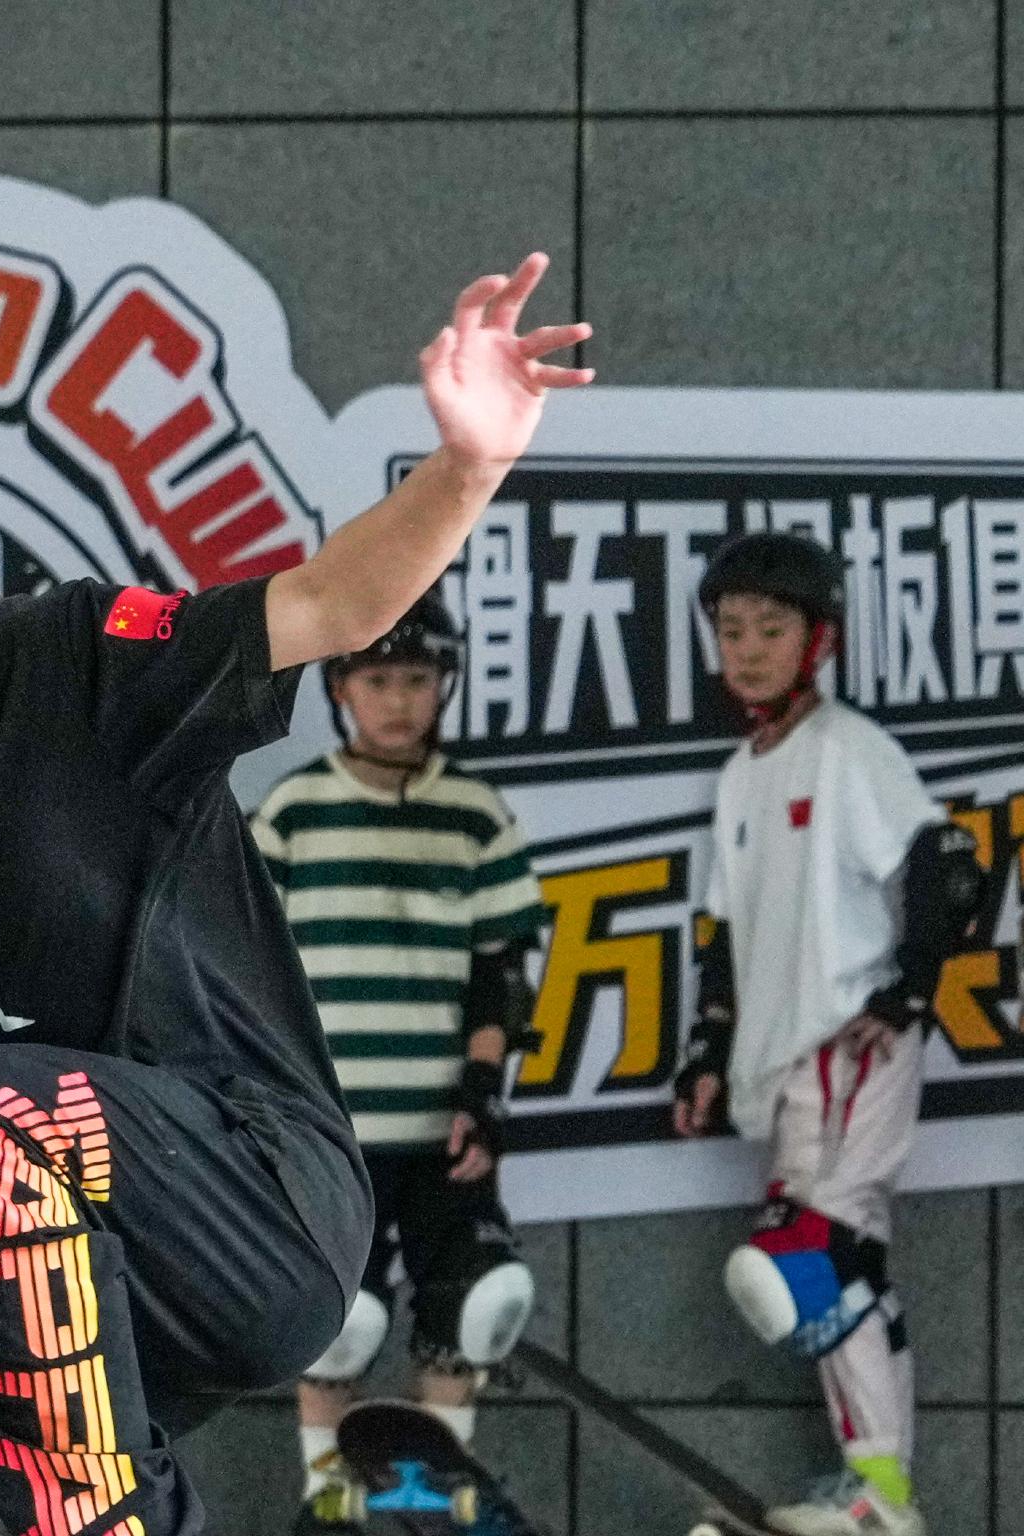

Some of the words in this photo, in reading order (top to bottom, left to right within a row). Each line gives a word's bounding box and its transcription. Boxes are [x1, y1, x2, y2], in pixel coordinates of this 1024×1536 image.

[437, 494, 1024, 741] 滑天下板俱
